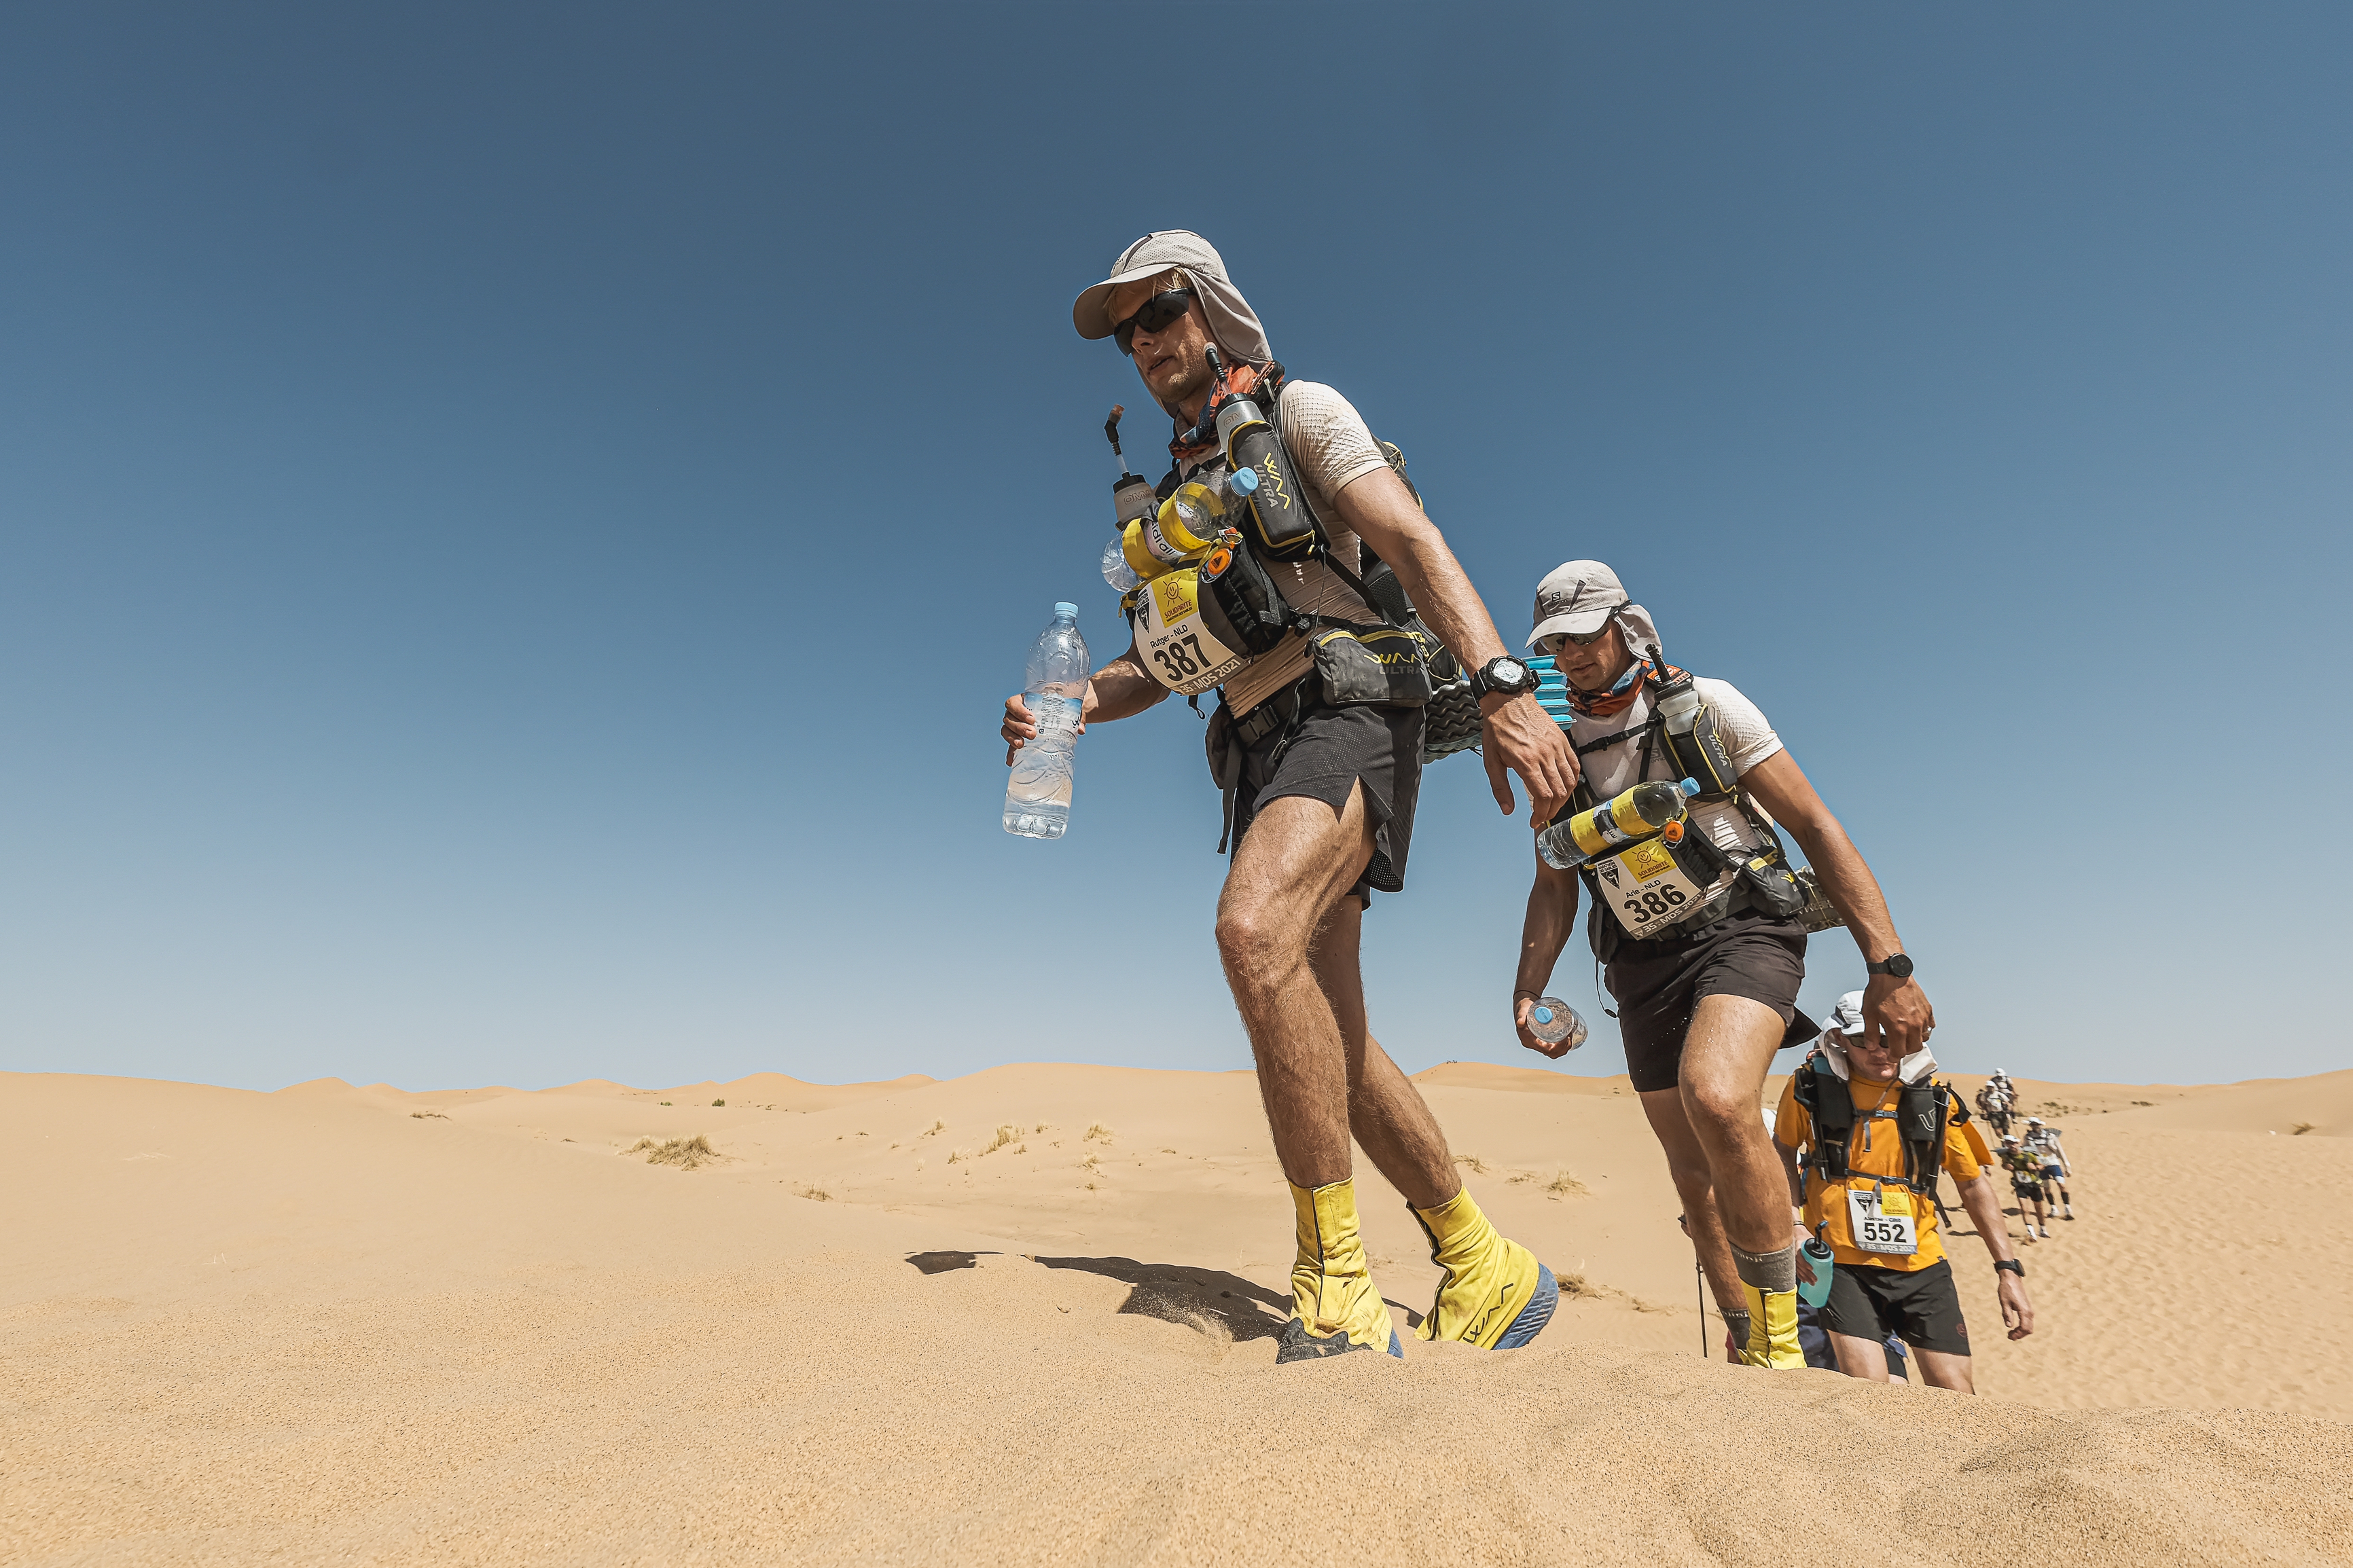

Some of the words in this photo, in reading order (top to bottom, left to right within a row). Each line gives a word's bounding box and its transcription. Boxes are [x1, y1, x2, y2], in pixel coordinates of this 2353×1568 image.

[1253, 464, 1278, 508] ULTRA
[1150, 635, 1170, 649] Rutger
[1173, 624, 1188, 637] NLD
[1153, 632, 1213, 682] 387
[1379, 666, 1421, 675] ULTRA
[1193, 672, 1219, 690] MDS
[1215, 659, 1241, 678] 2021
[1708, 735, 1728, 766] ULTRA
[1626, 889, 1640, 898] Arie
[1645, 879, 1661, 890] NLD
[1624, 884, 1687, 923] 386
[1660, 909, 1683, 924] MDS
[1864, 1222, 1907, 1243] 552
